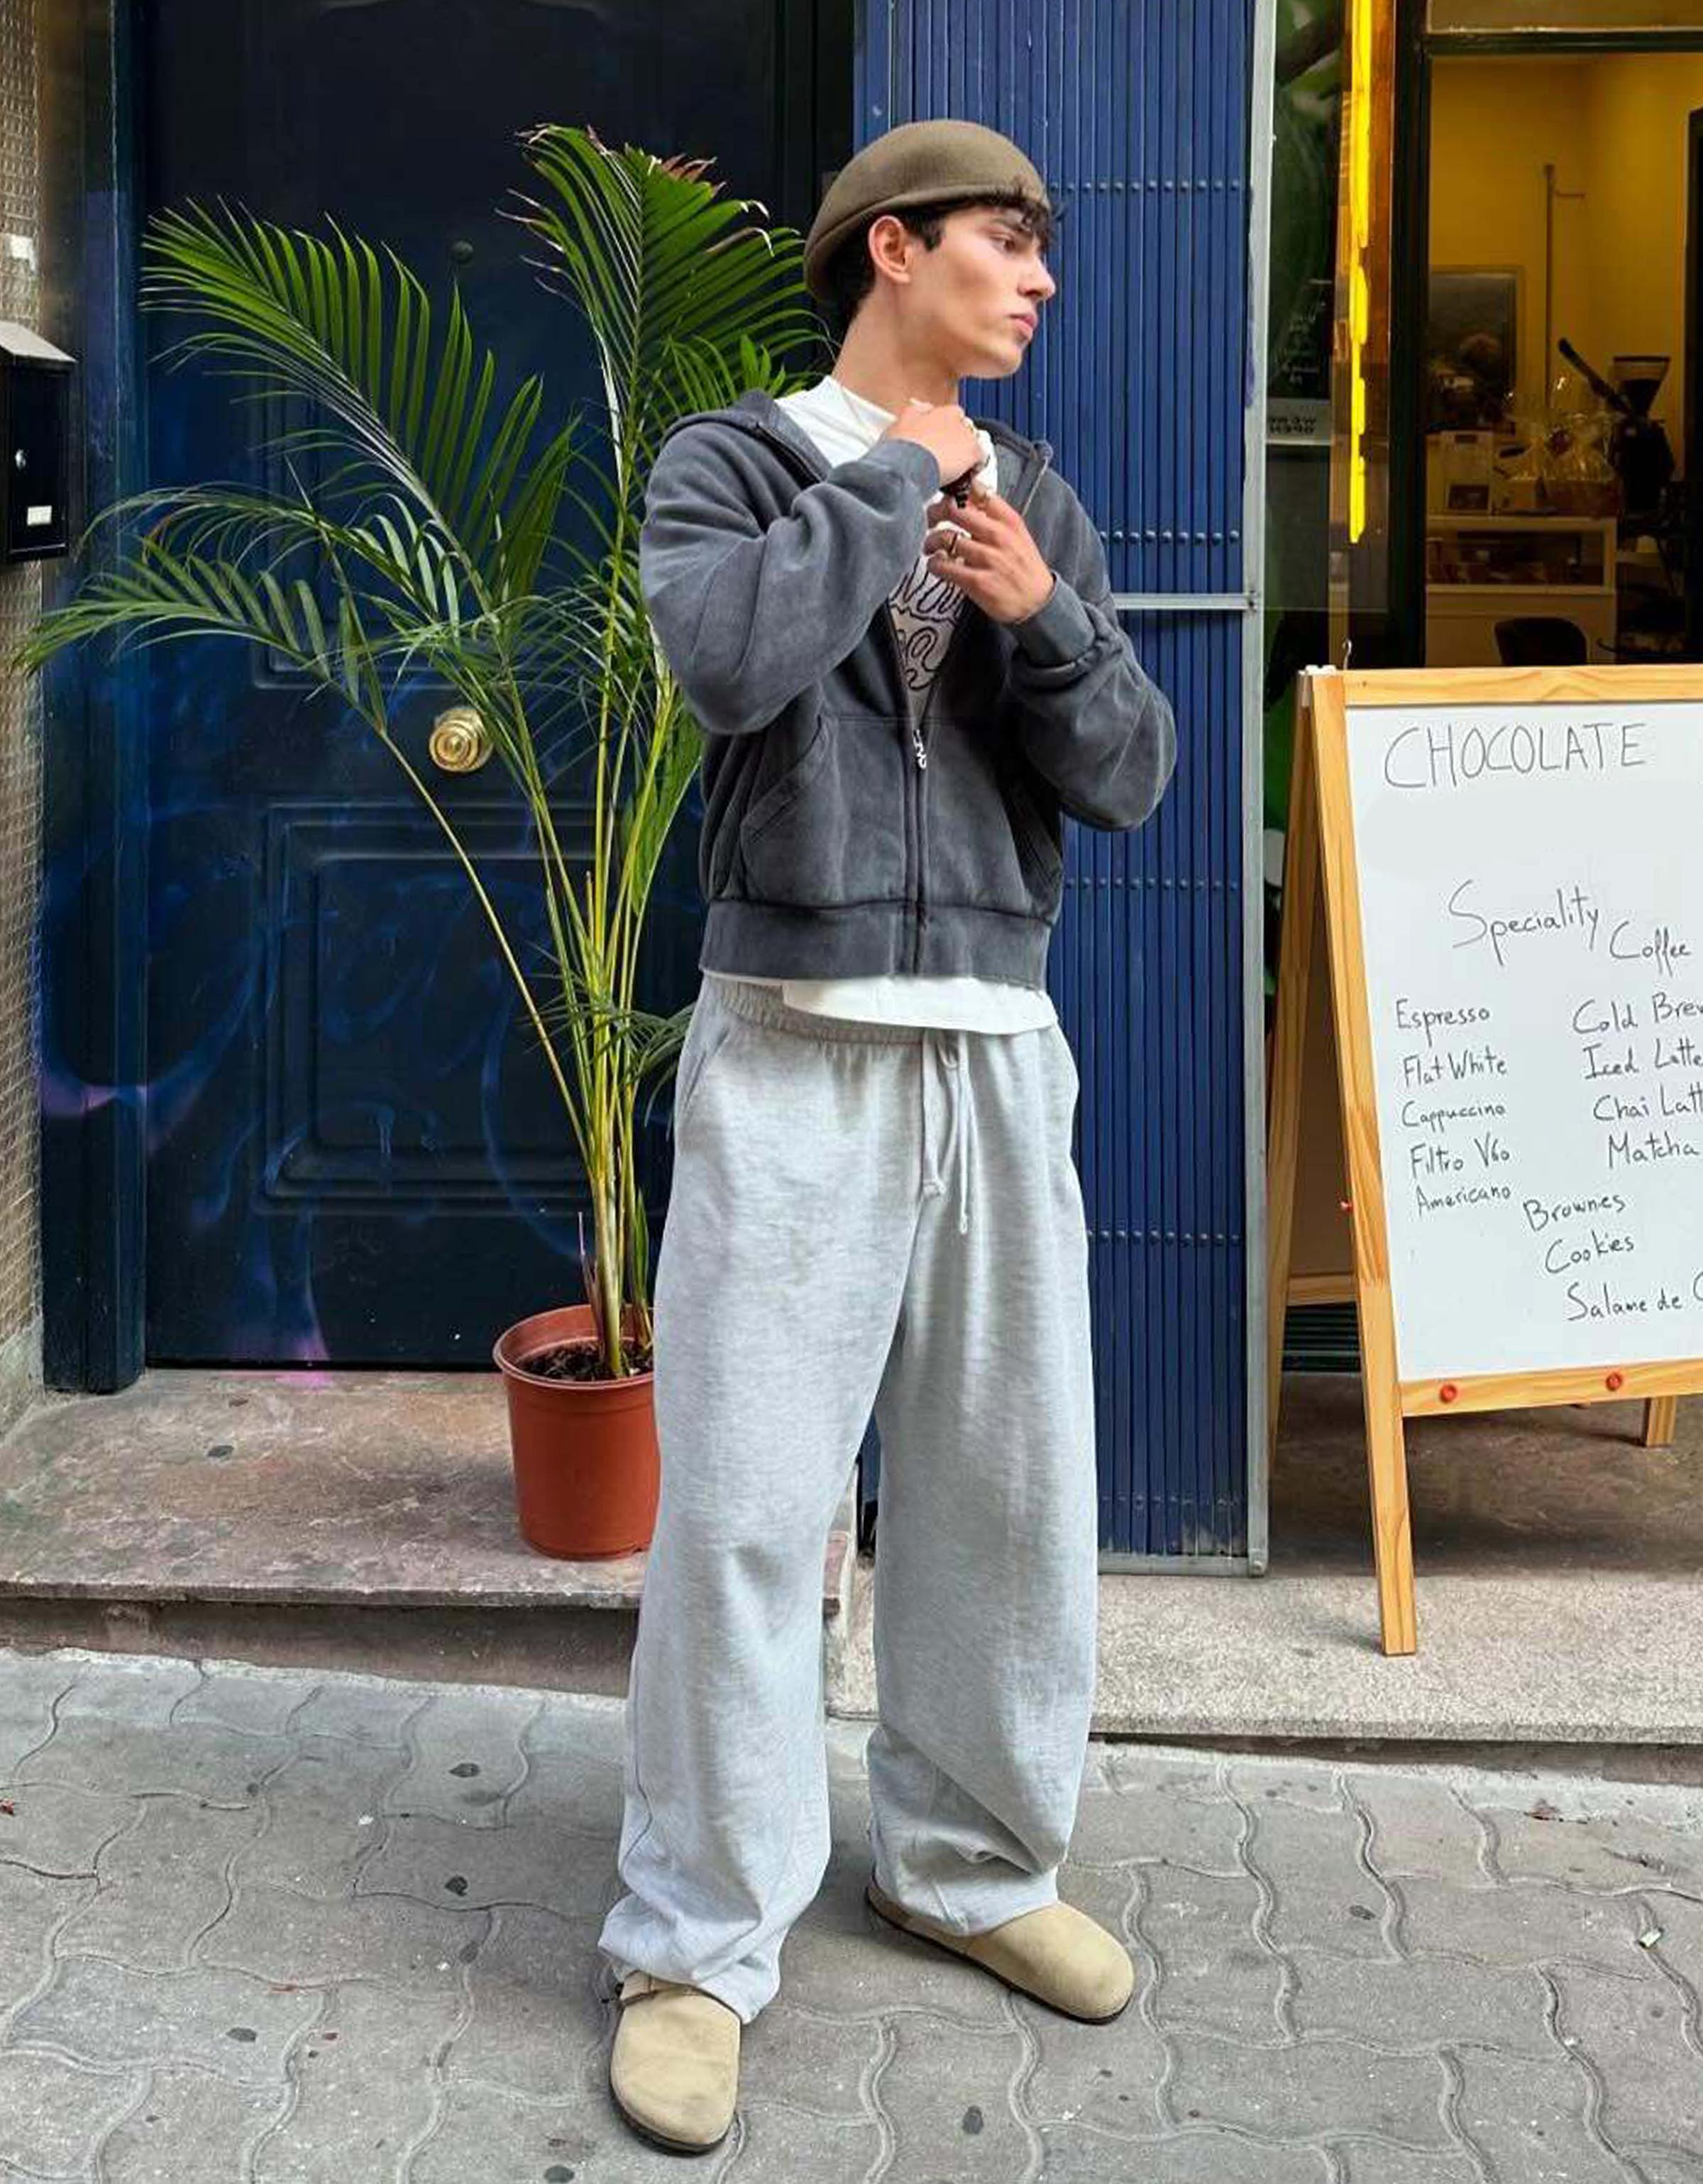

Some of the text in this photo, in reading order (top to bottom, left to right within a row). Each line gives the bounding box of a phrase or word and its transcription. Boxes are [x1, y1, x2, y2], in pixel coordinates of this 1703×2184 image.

[1384, 723, 1646, 788] CHOCOLATE
[1448, 879, 1692, 977] Speciality Coffee
[1396, 997, 1491, 1048] Espresso
[1572, 999, 1639, 1035] Cold
[1404, 1045, 1508, 1088] Flat White
[1583, 1037, 1703, 1079] Iced Latte
[1401, 1100, 1506, 1134] Cappuccino
[1593, 1094, 1650, 1121] Chai
[1410, 1142, 1464, 1179] Filtro
[1609, 1130, 1700, 1169] Matcha
[1416, 1185, 1512, 1216] Americano
[1545, 1228, 1634, 1274] Cookies
[1657, 1287, 1682, 1311] de
